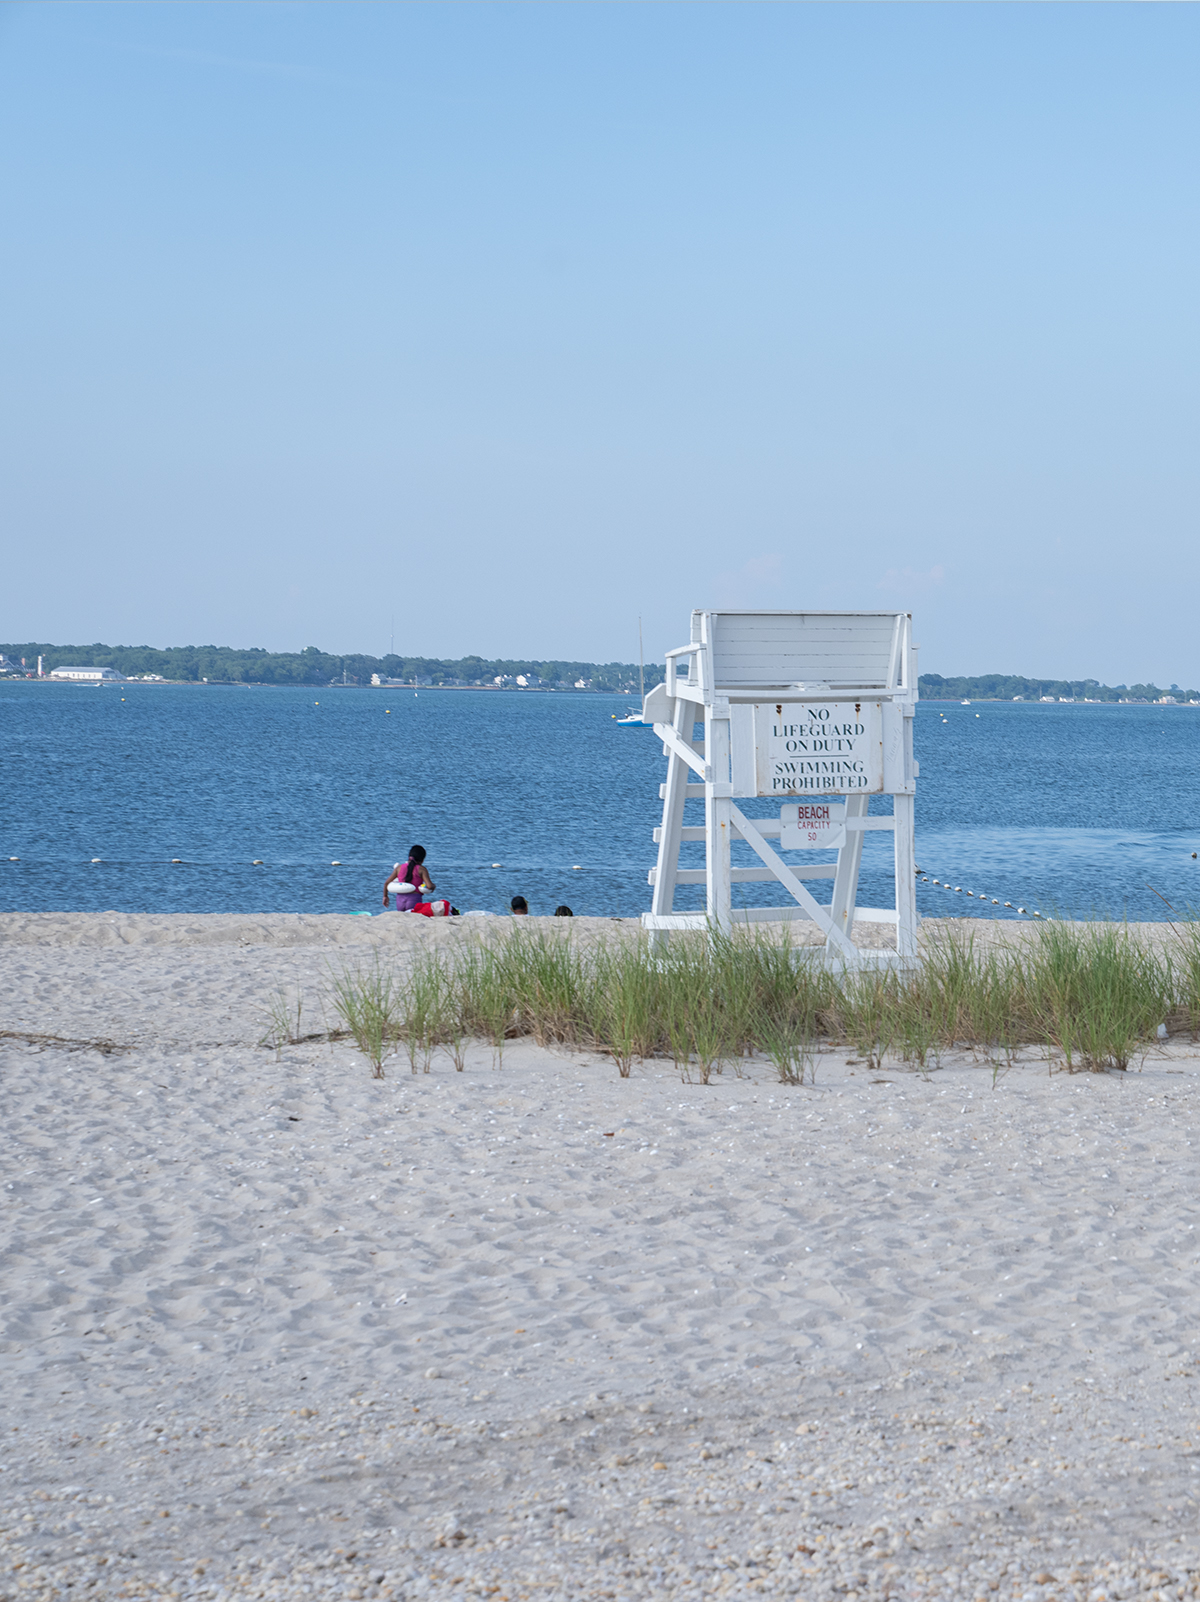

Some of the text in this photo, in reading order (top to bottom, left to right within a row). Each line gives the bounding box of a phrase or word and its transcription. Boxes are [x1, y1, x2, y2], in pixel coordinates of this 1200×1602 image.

[807, 708, 830, 721] NO
[773, 723, 865, 737] LIFEGUARD
[785, 738, 857, 752] ON DUTY
[774, 760, 864, 775] SWIMMING
[772, 775, 868, 789] PROHIBITED
[798, 806, 830, 819] BEACH
[797, 821, 831, 830] CAPACITY
[807, 832, 817, 841] 50
